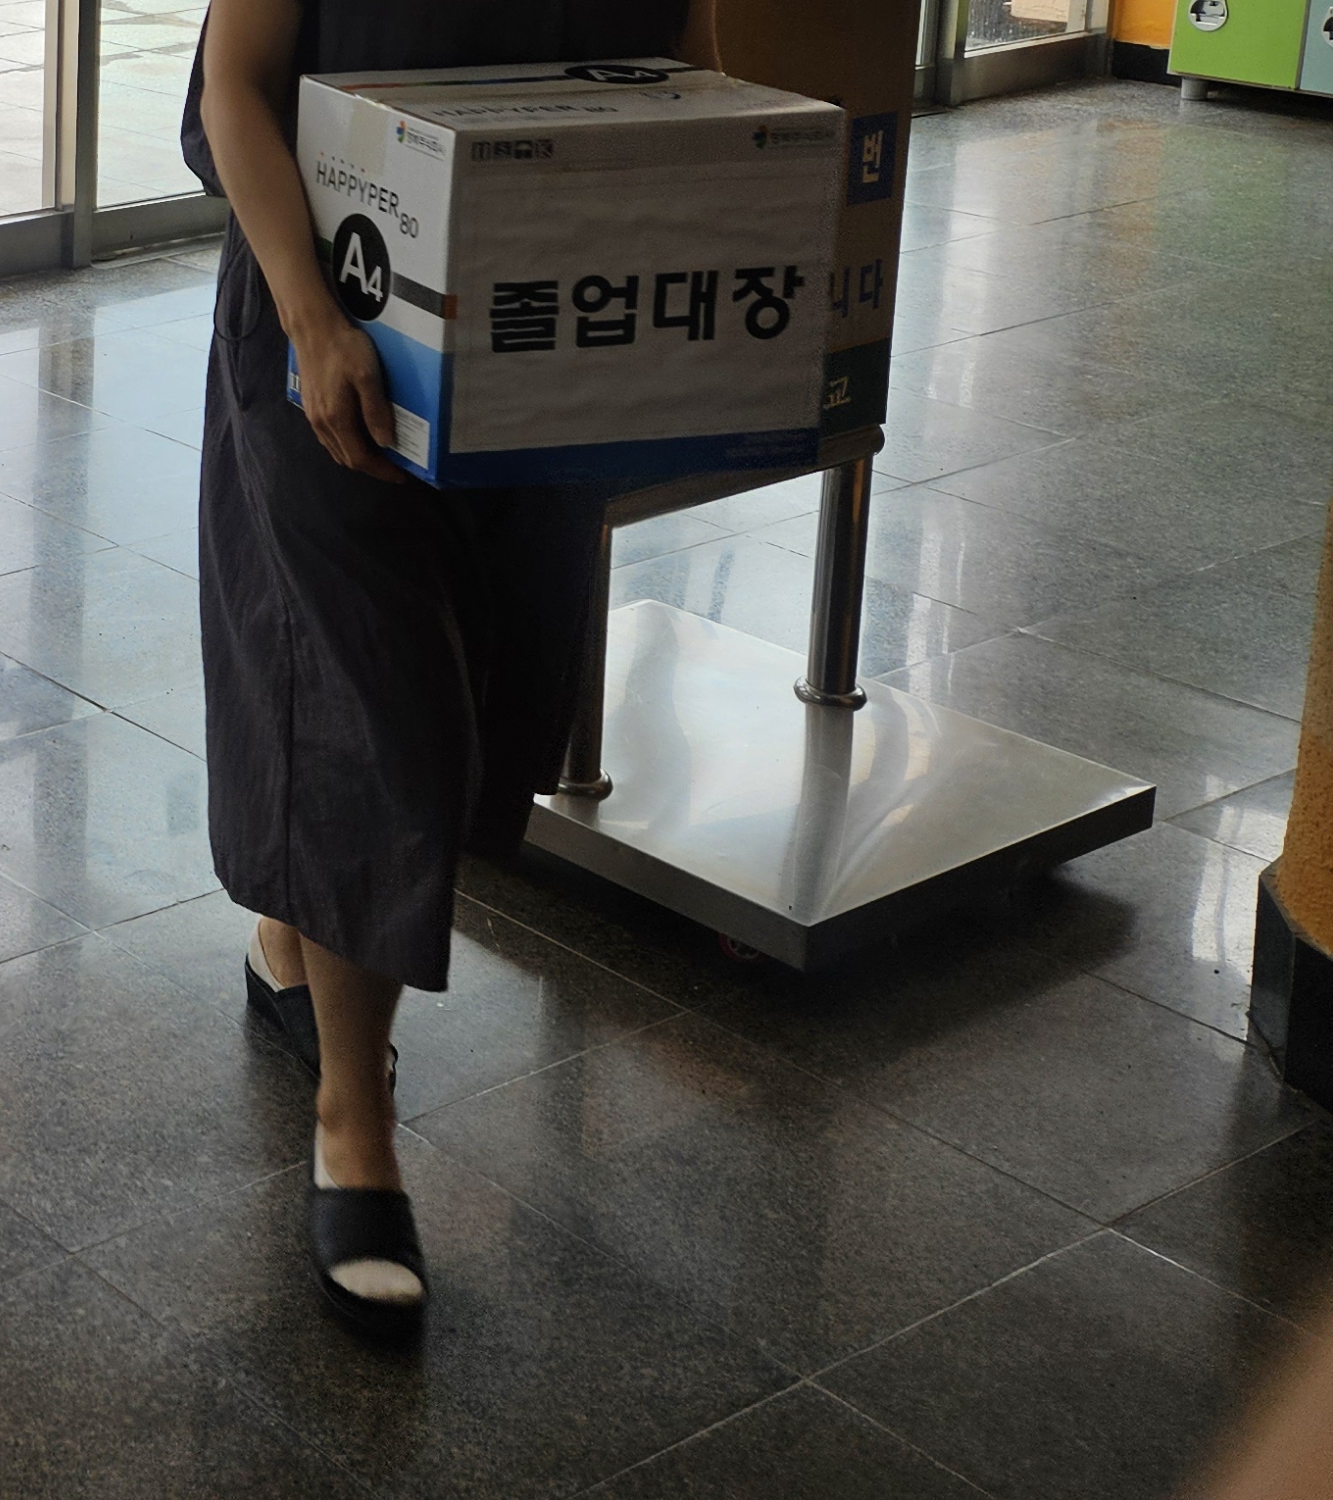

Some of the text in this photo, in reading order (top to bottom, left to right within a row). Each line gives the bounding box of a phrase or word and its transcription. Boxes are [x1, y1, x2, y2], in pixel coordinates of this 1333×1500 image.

[862, 130, 884, 184] 번
[316, 161, 420, 239] HAPPYPER 80
[339, 231, 384, 303] A4
[489, 265, 805, 355] 졸업대장
